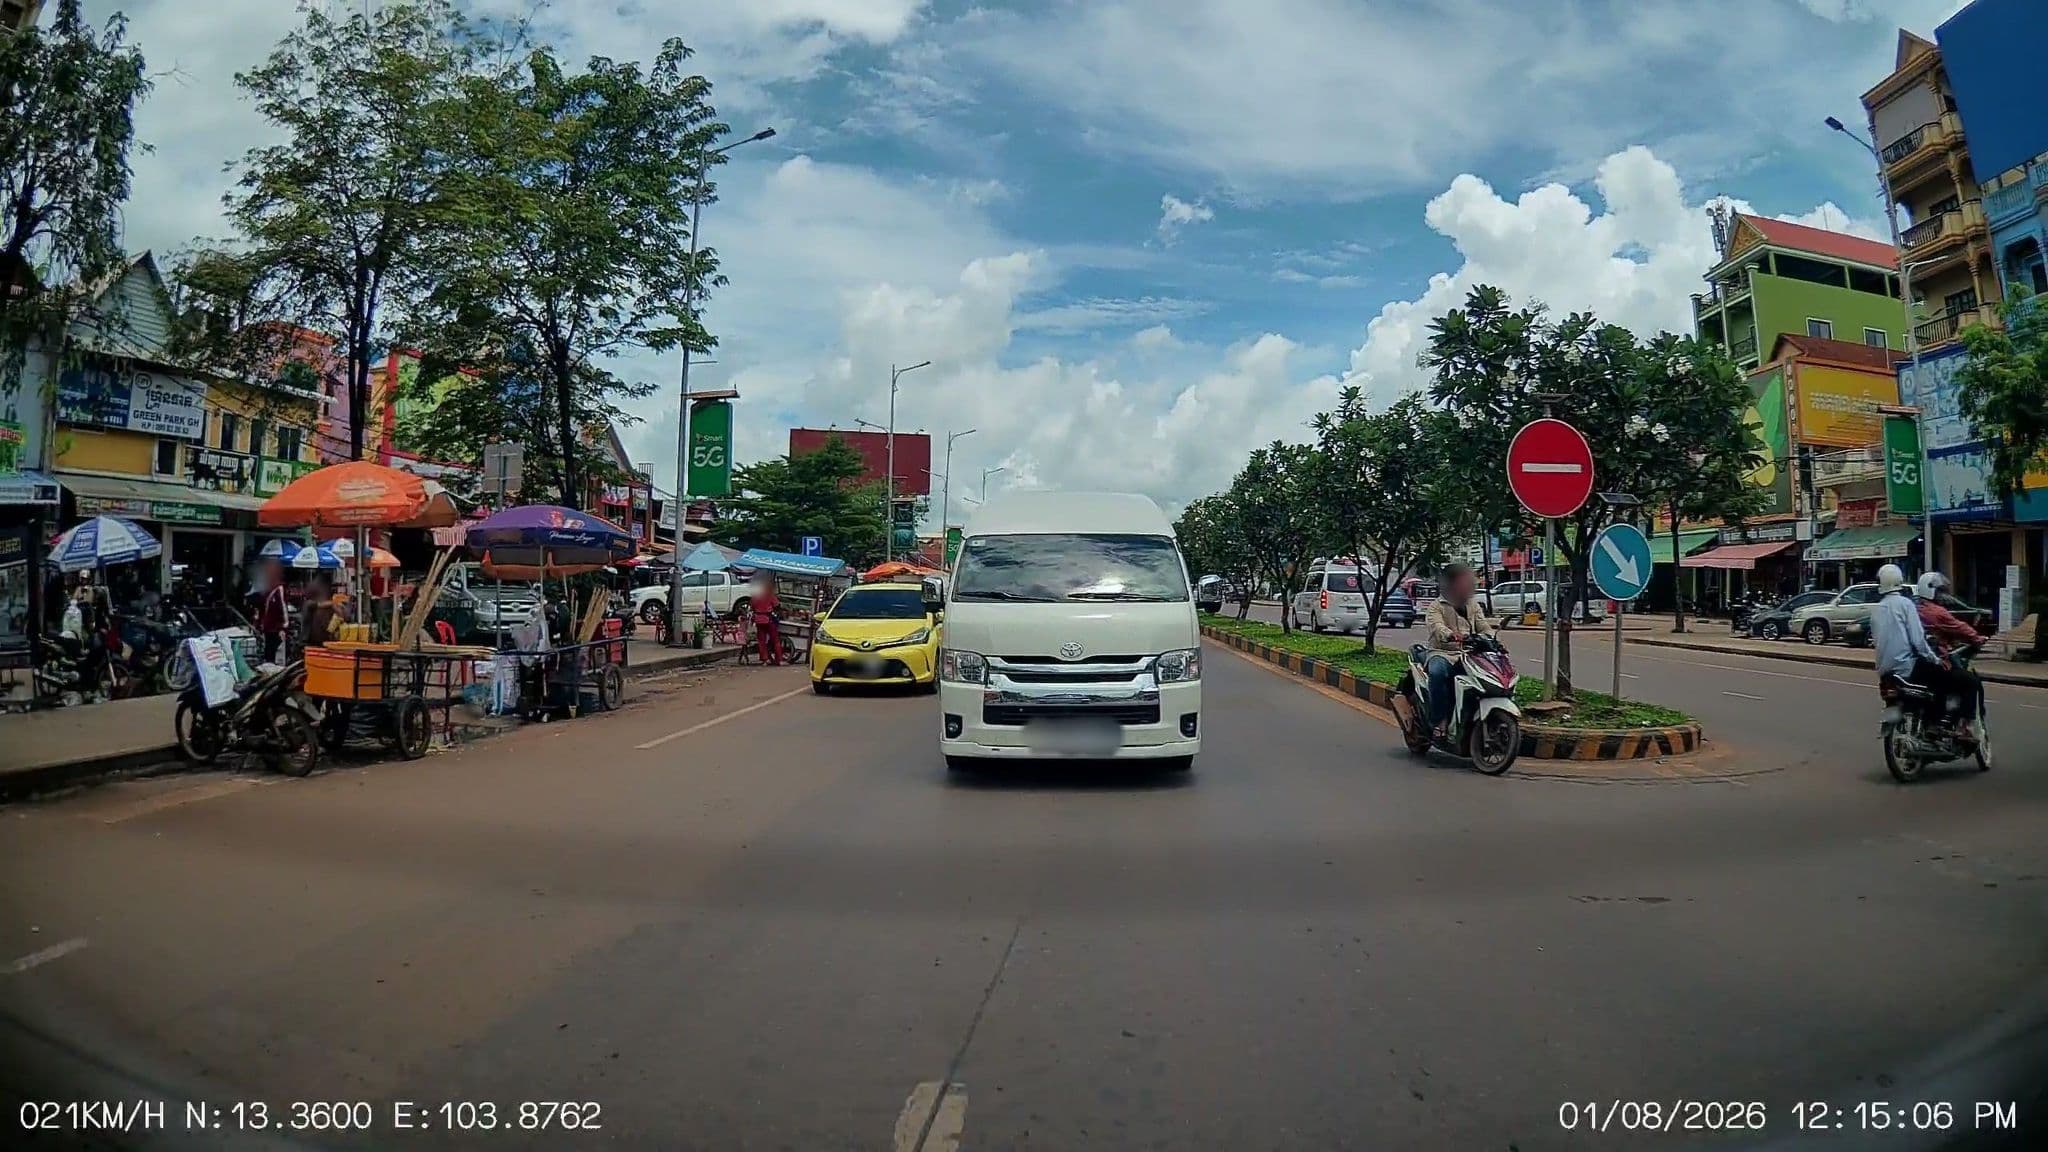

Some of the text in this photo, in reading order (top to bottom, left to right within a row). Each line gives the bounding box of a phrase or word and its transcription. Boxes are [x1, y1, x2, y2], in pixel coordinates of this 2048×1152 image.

[133, 409, 162, 422] GREEN
[164, 414, 185, 425] PARK
[187, 417, 200, 428] GH
[703, 434, 723, 442] Smart
[693, 446, 725, 467] 5G
[1891, 462, 1918, 485] 5G
[806, 538, 818, 556] P
[1531, 548, 1541, 564] P
